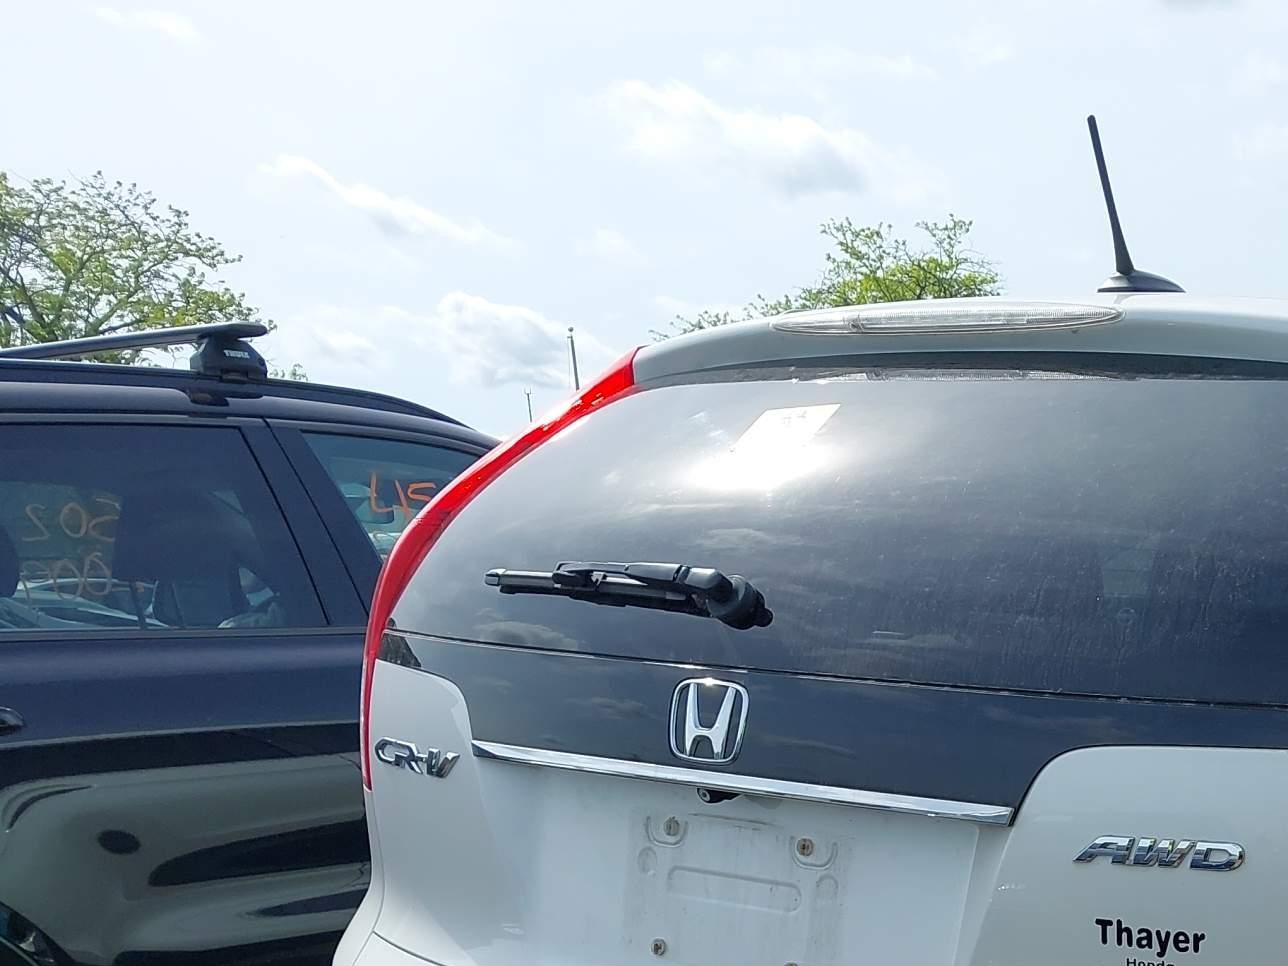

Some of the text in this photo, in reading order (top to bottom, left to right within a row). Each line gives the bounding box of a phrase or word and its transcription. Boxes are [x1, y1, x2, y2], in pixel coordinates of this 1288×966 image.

[375, 737, 460, 778] CR-V
[1072, 835, 1245, 872] AWD
[1095, 918, 1206, 957] Thayer
